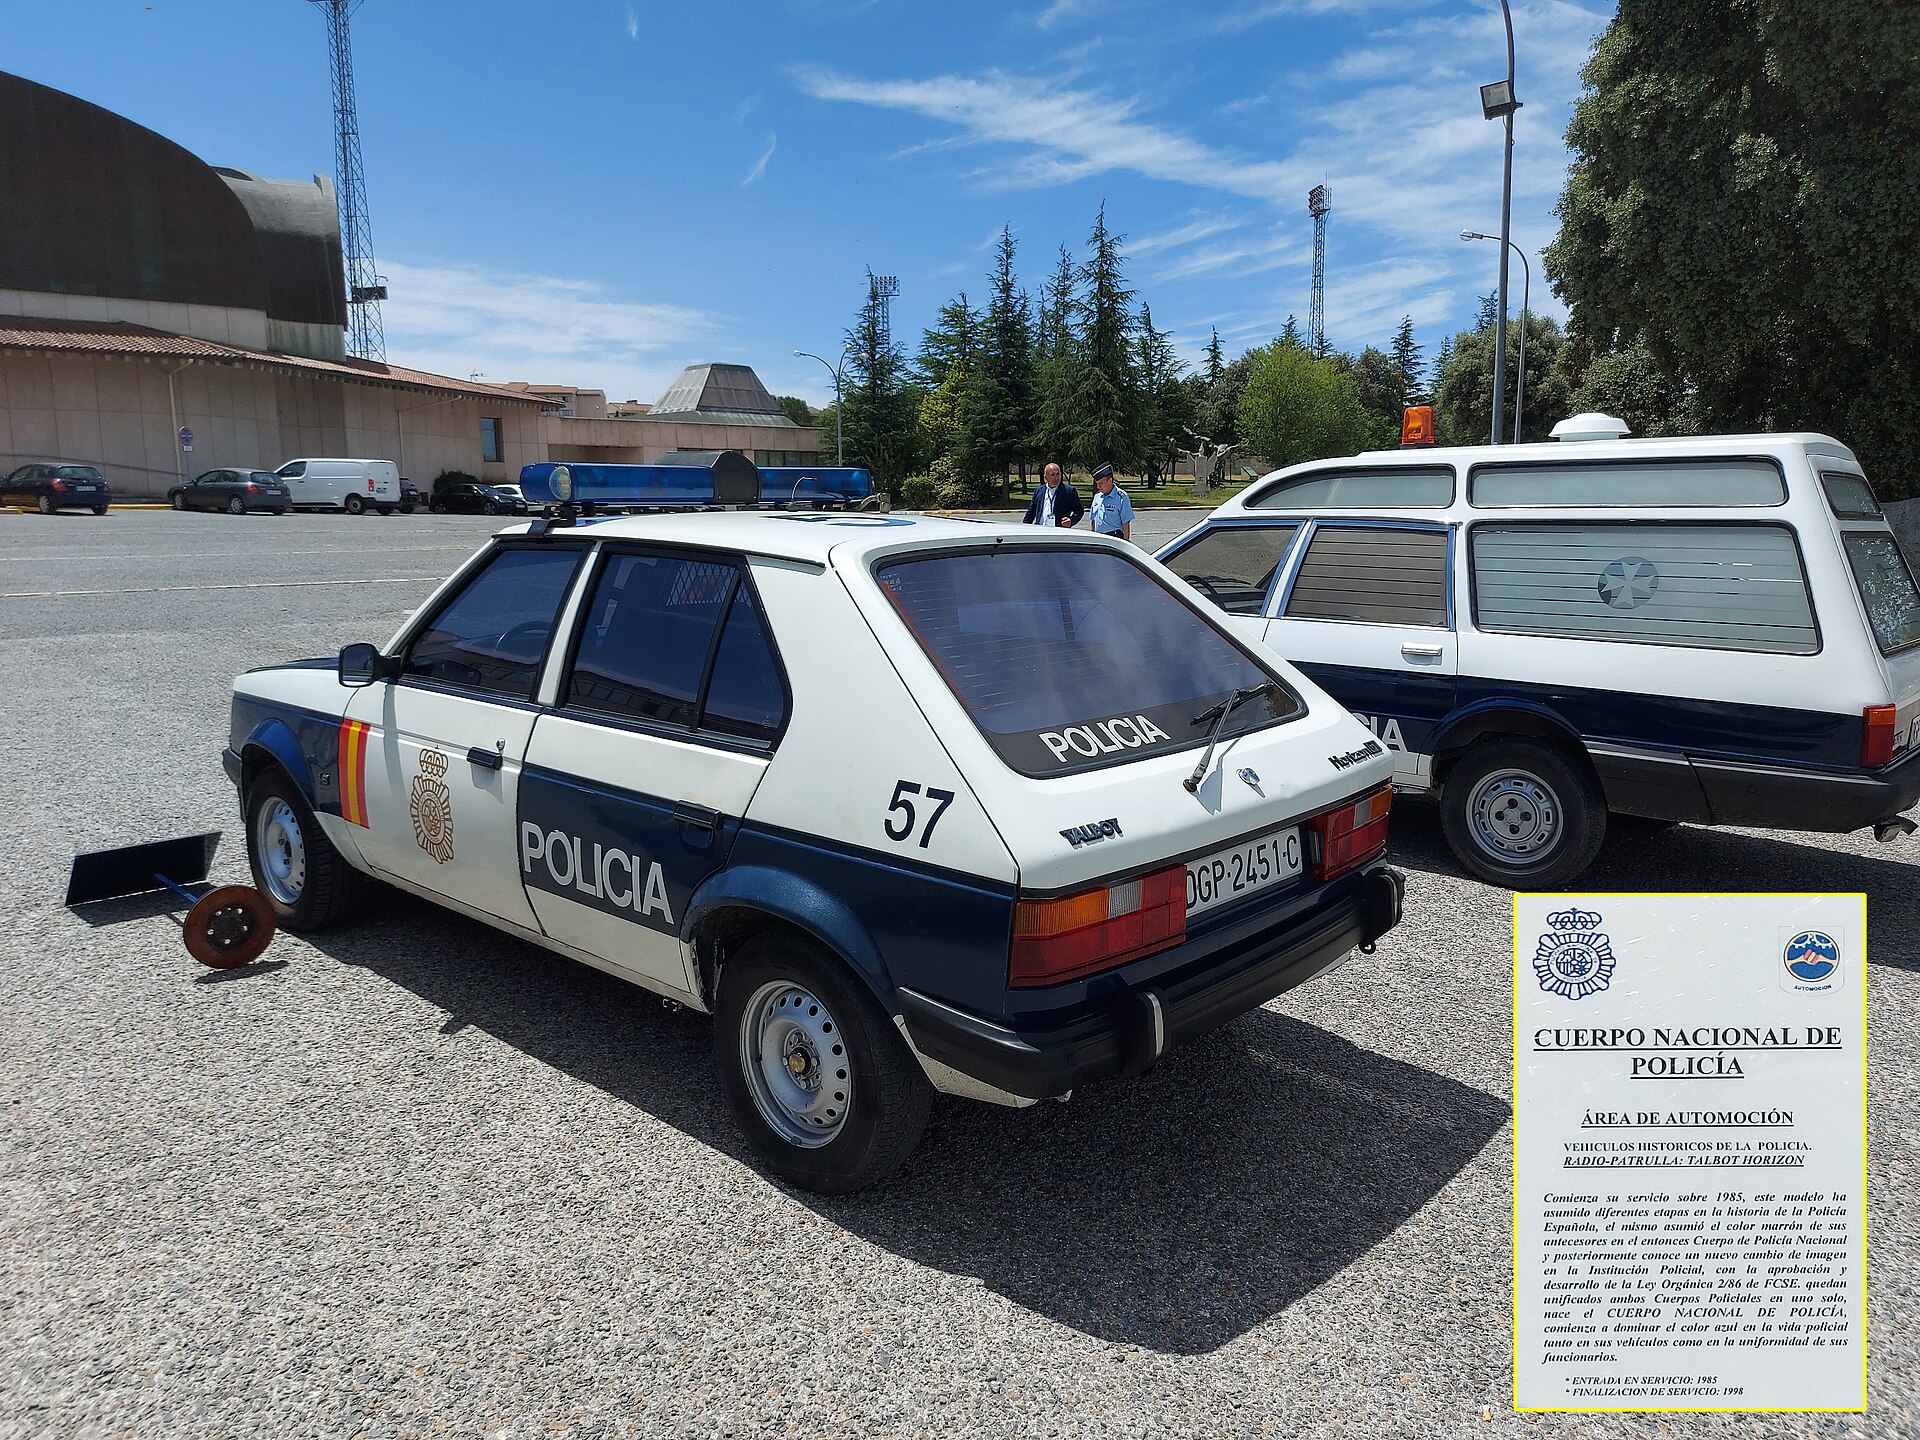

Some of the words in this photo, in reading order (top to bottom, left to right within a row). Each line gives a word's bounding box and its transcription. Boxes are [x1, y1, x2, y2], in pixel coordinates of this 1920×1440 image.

[1039, 715, 1171, 763] POLICIA
[884, 779, 955, 849] 57
[1059, 817, 1123, 847] TALBOT
[521, 820, 675, 925] POLICIA
